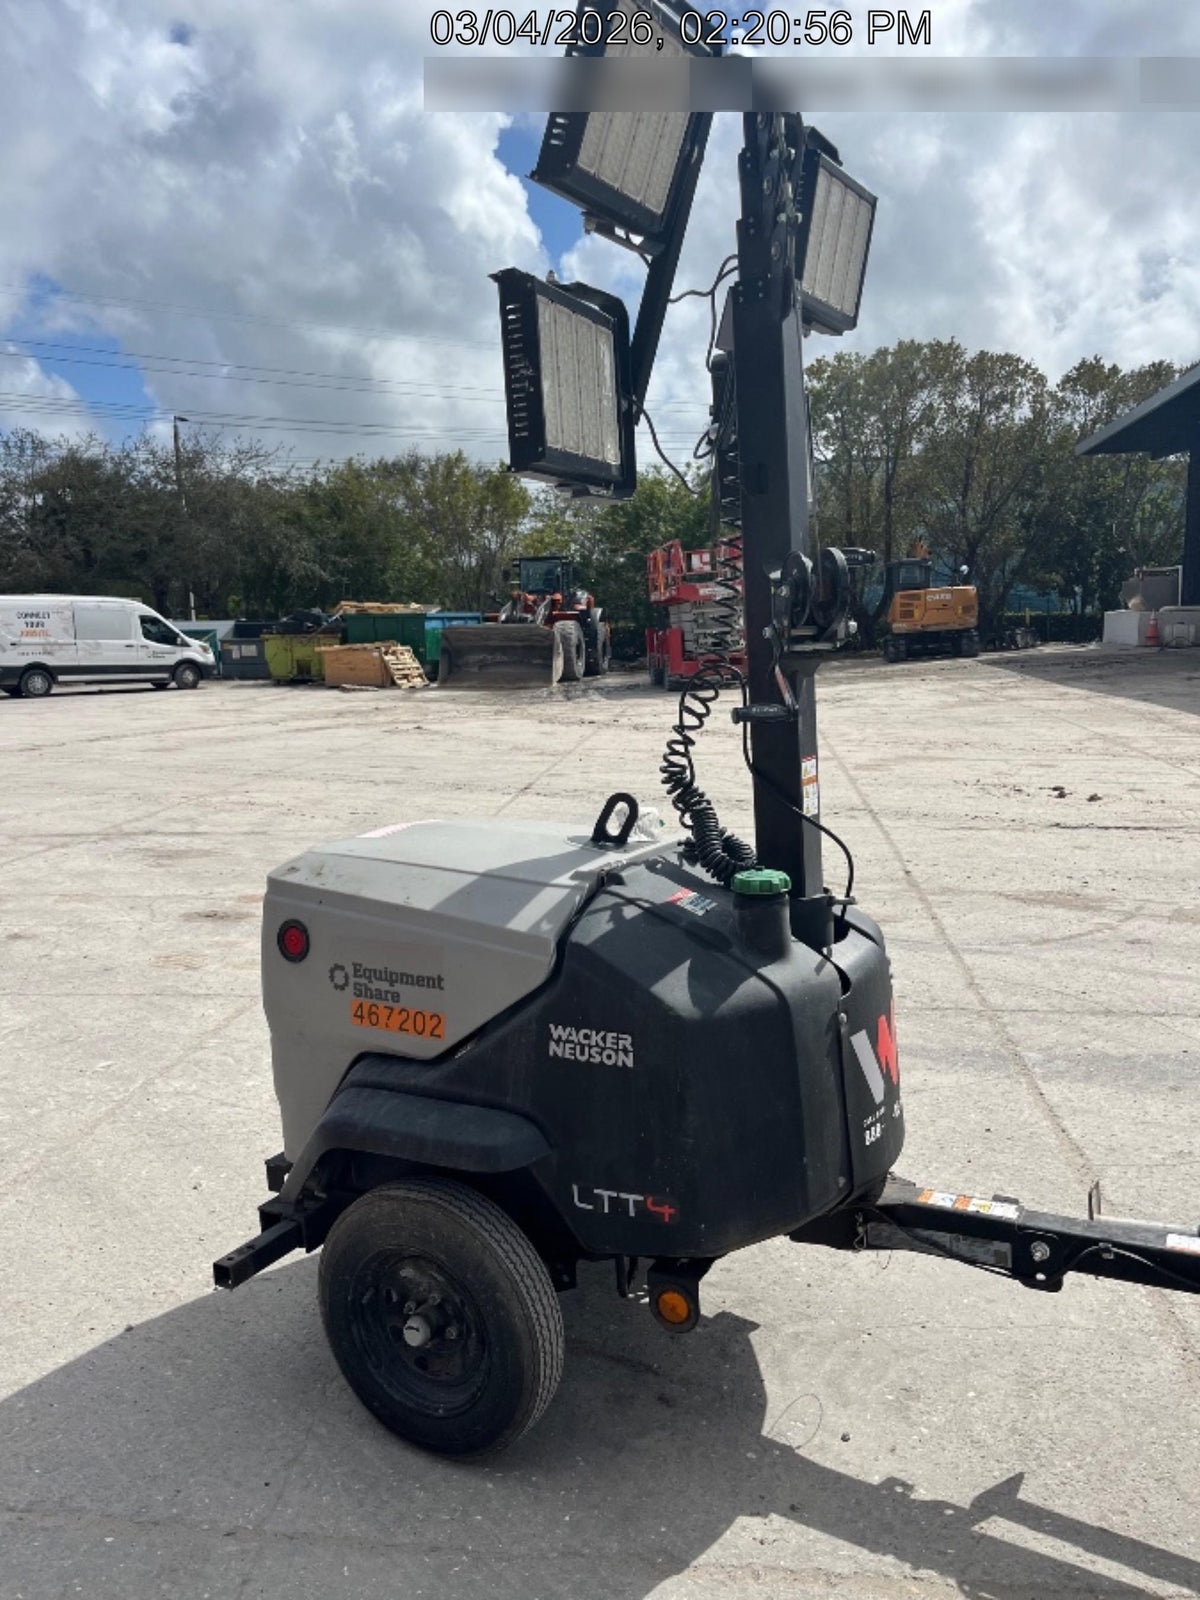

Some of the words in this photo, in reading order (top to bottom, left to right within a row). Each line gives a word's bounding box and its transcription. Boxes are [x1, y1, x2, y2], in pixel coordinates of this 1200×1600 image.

[352, 962, 444, 990] Equipment
[353, 982, 400, 1003] Share
[353, 1002, 442, 1039] 467202
[549, 1023, 633, 1050] WACKER
[549, 1040, 634, 1068] NEUSON
[572, 1184, 676, 1223] LTT4
